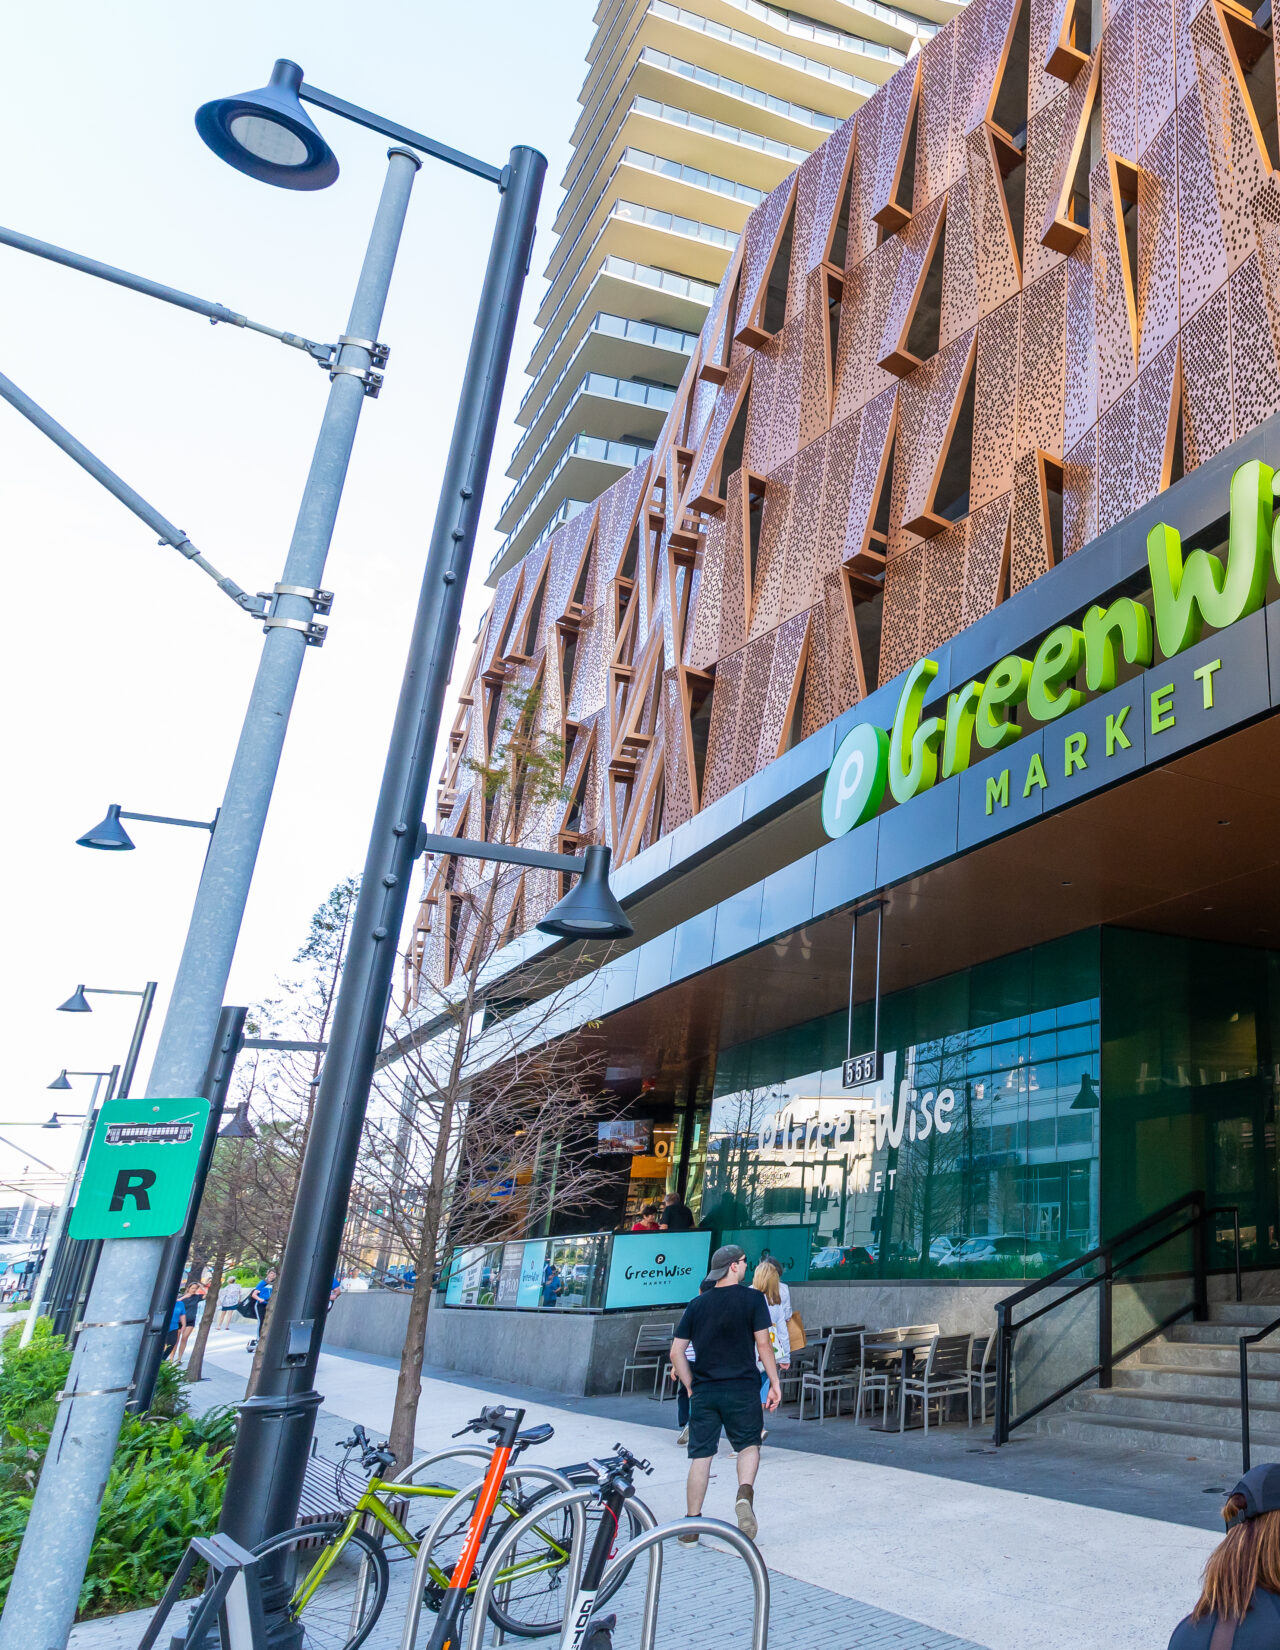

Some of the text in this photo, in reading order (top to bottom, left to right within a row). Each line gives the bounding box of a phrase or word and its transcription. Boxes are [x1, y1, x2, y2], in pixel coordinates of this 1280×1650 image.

[984, 657, 1223, 815] MARKET
[846, 1057, 872, 1084] 555
[782, 1079, 956, 1167] GreenWise
[108, 1168, 157, 1212] R
[817, 1169, 898, 1199] MARKET
[624, 1265, 692, 1280] GreenWise
